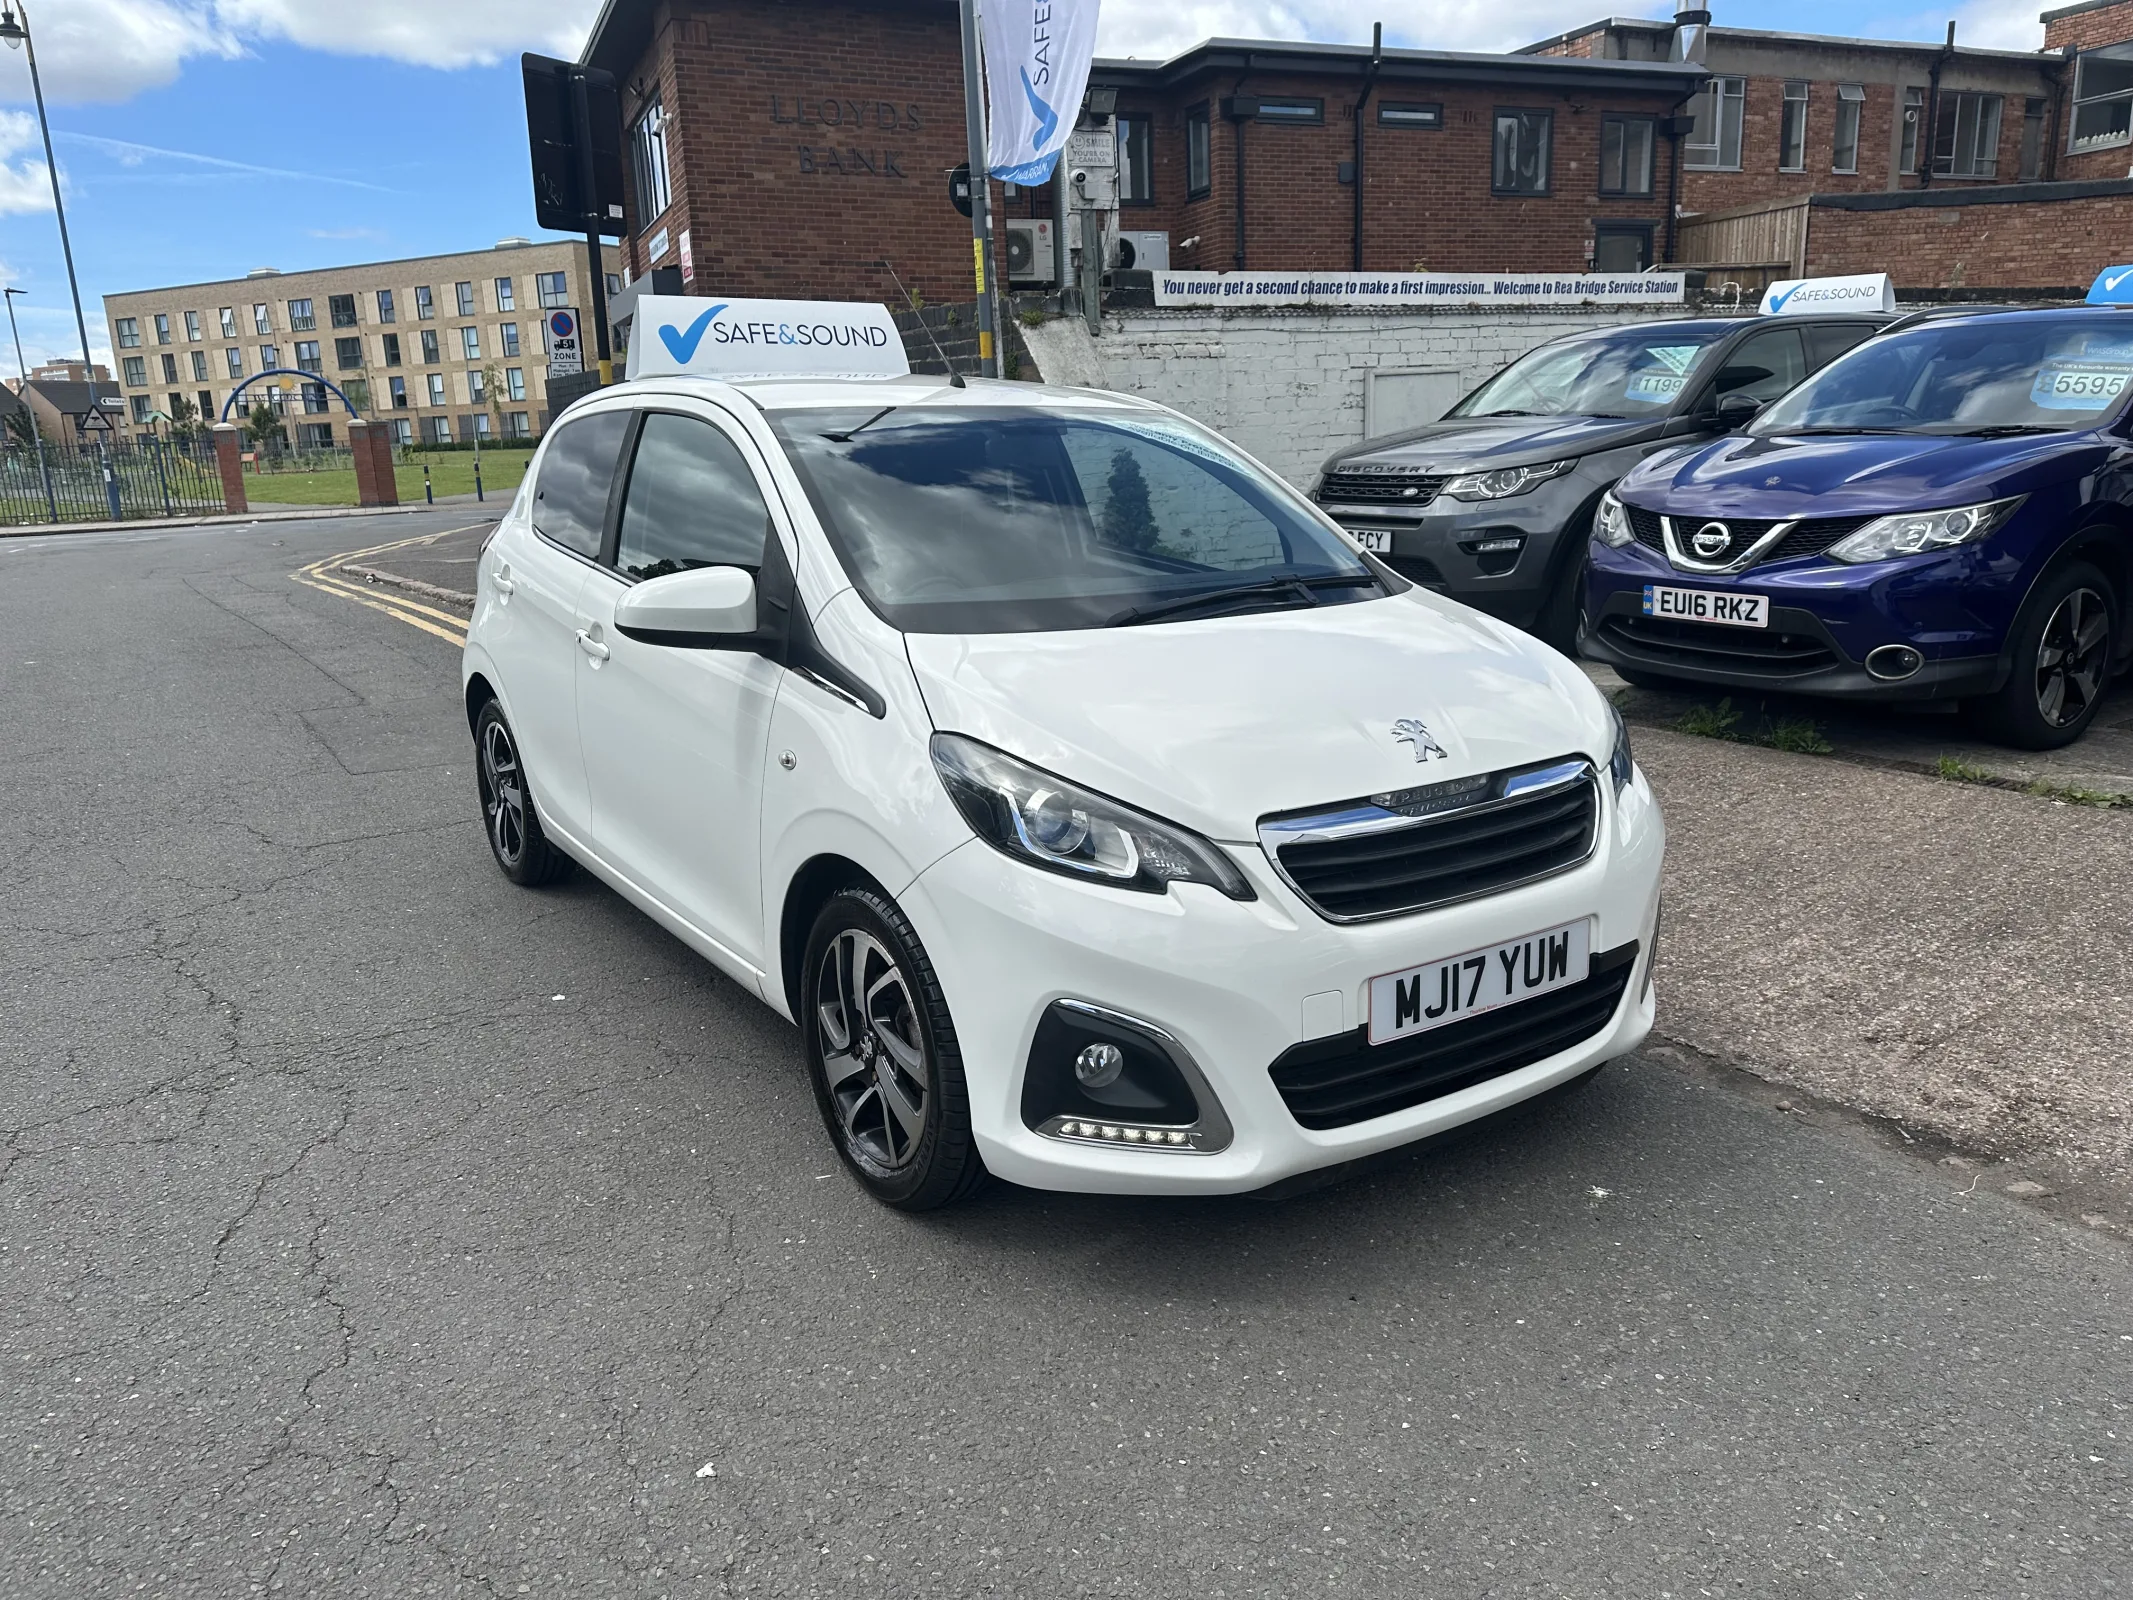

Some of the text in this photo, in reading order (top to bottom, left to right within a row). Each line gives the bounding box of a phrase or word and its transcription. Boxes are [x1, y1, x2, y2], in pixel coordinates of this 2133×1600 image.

[1033, 0, 1052, 86] SAFE
[771, 94, 922, 131] LLOYDS
[1085, 138, 1111, 148] SMILE
[798, 145, 908, 178] BANK
[1163, 279, 1678, 296] You never get a second chance to make a first impression... Welcome to Rea Bridge Service Station
[1792, 286, 1876, 302] SAFE&SOUND
[713, 321, 888, 347] SAFE&SOUND
[554, 352, 576, 360] ZONE
[1337, 465, 1435, 473] DISCOVERY
[1643, 601, 1652, 609] UK
[1660, 590, 1759, 622] EU16 RKZ
[1395, 931, 1569, 1029] MJ17 YUW
